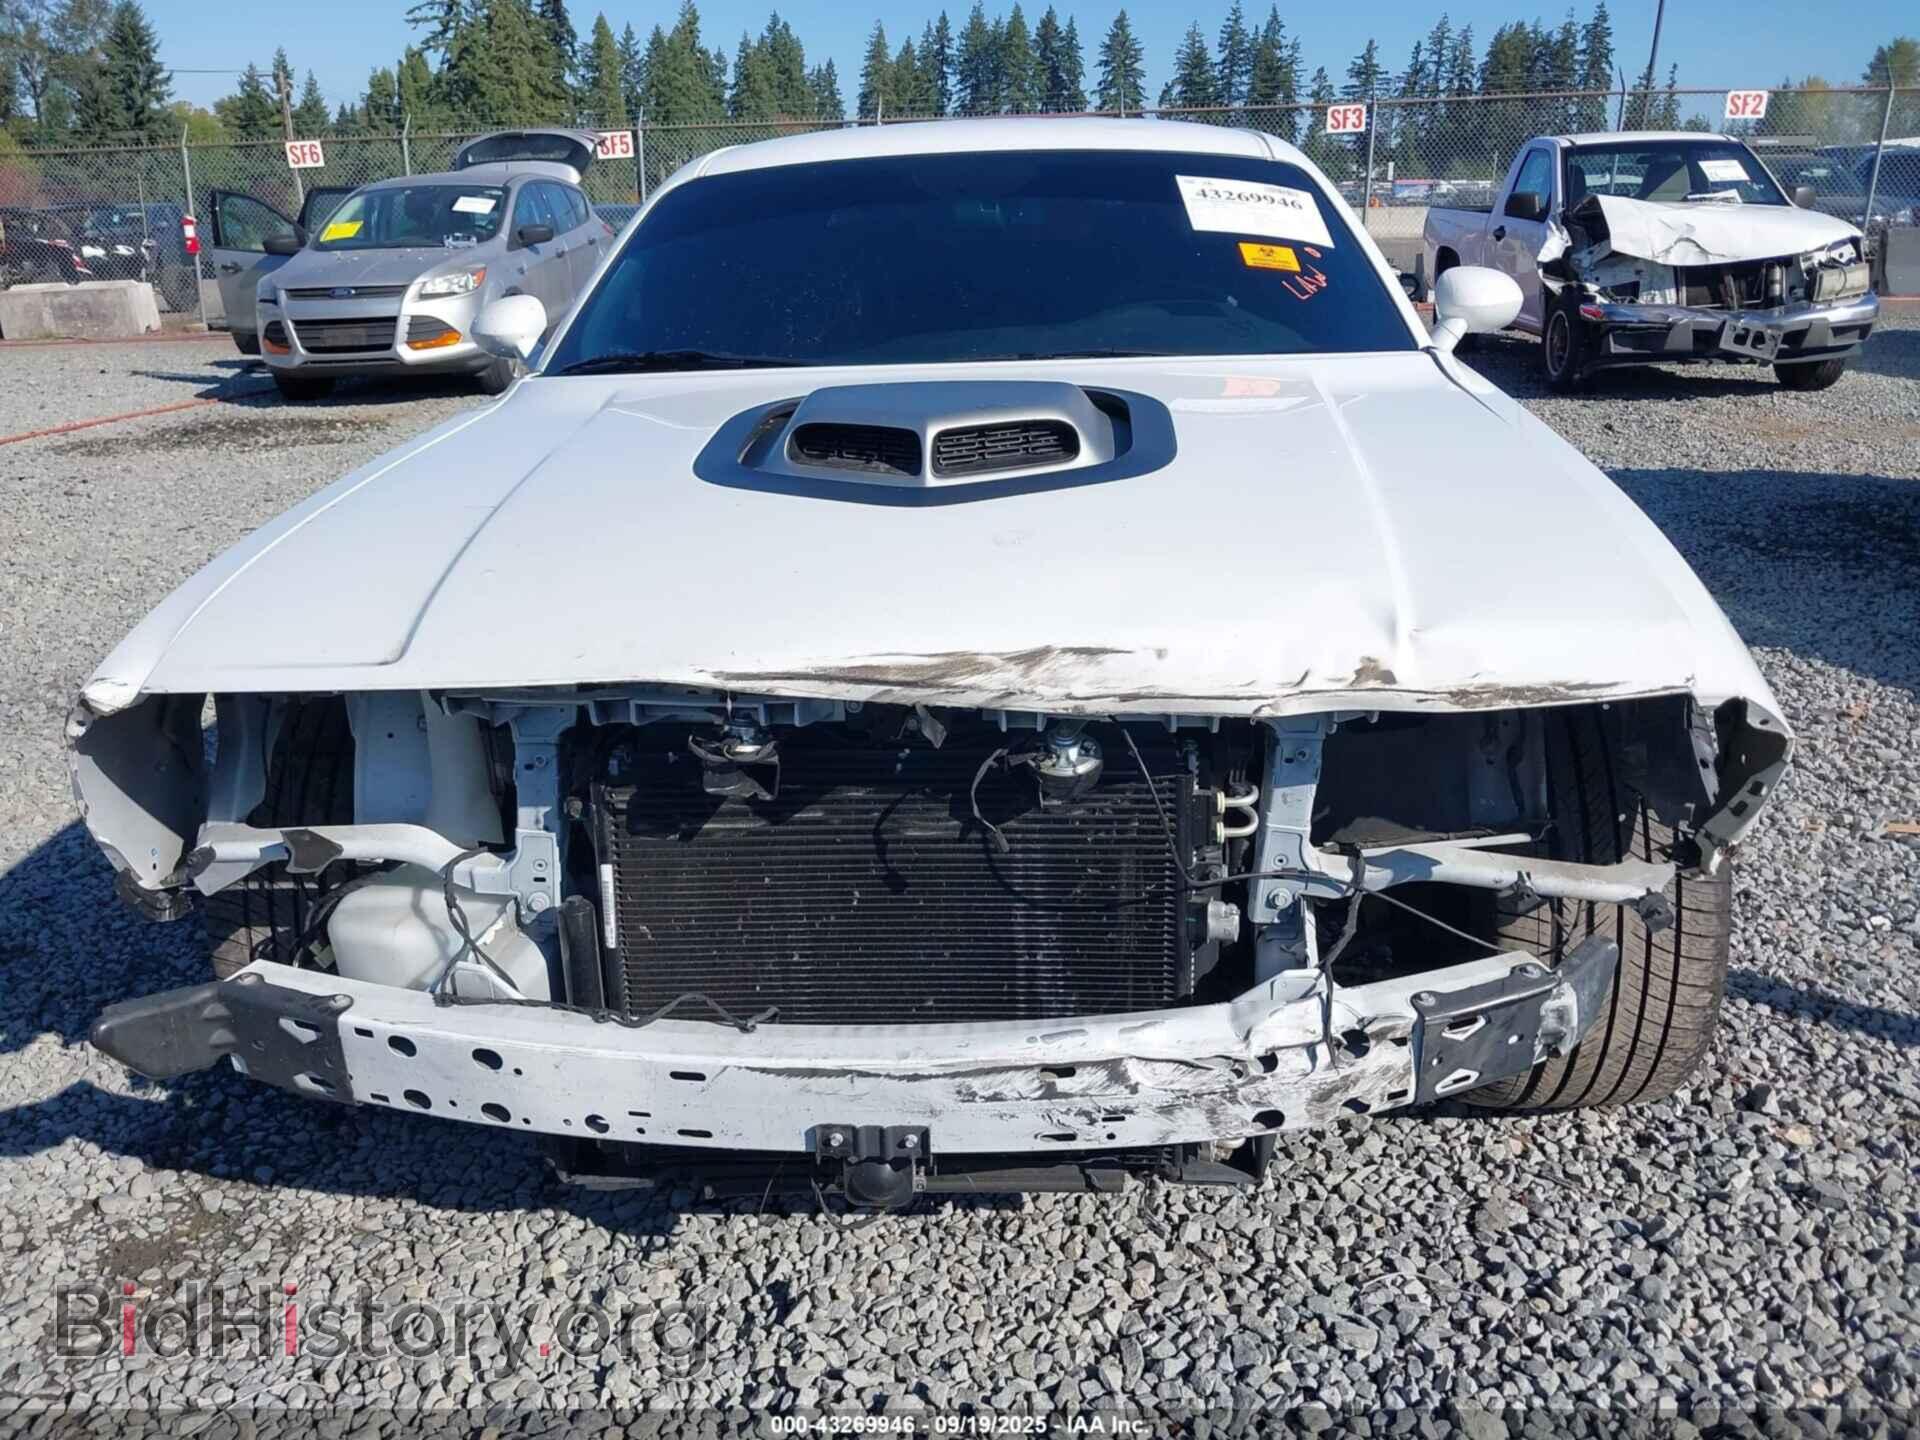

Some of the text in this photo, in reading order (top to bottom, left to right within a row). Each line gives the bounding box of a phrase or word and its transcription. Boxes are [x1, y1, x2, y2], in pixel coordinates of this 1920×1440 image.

[1729, 94, 1763, 115] SF2
[1330, 108, 1363, 129] SF3
[289, 143, 320, 164] SF6
[1196, 188, 1303, 209] 43269946
